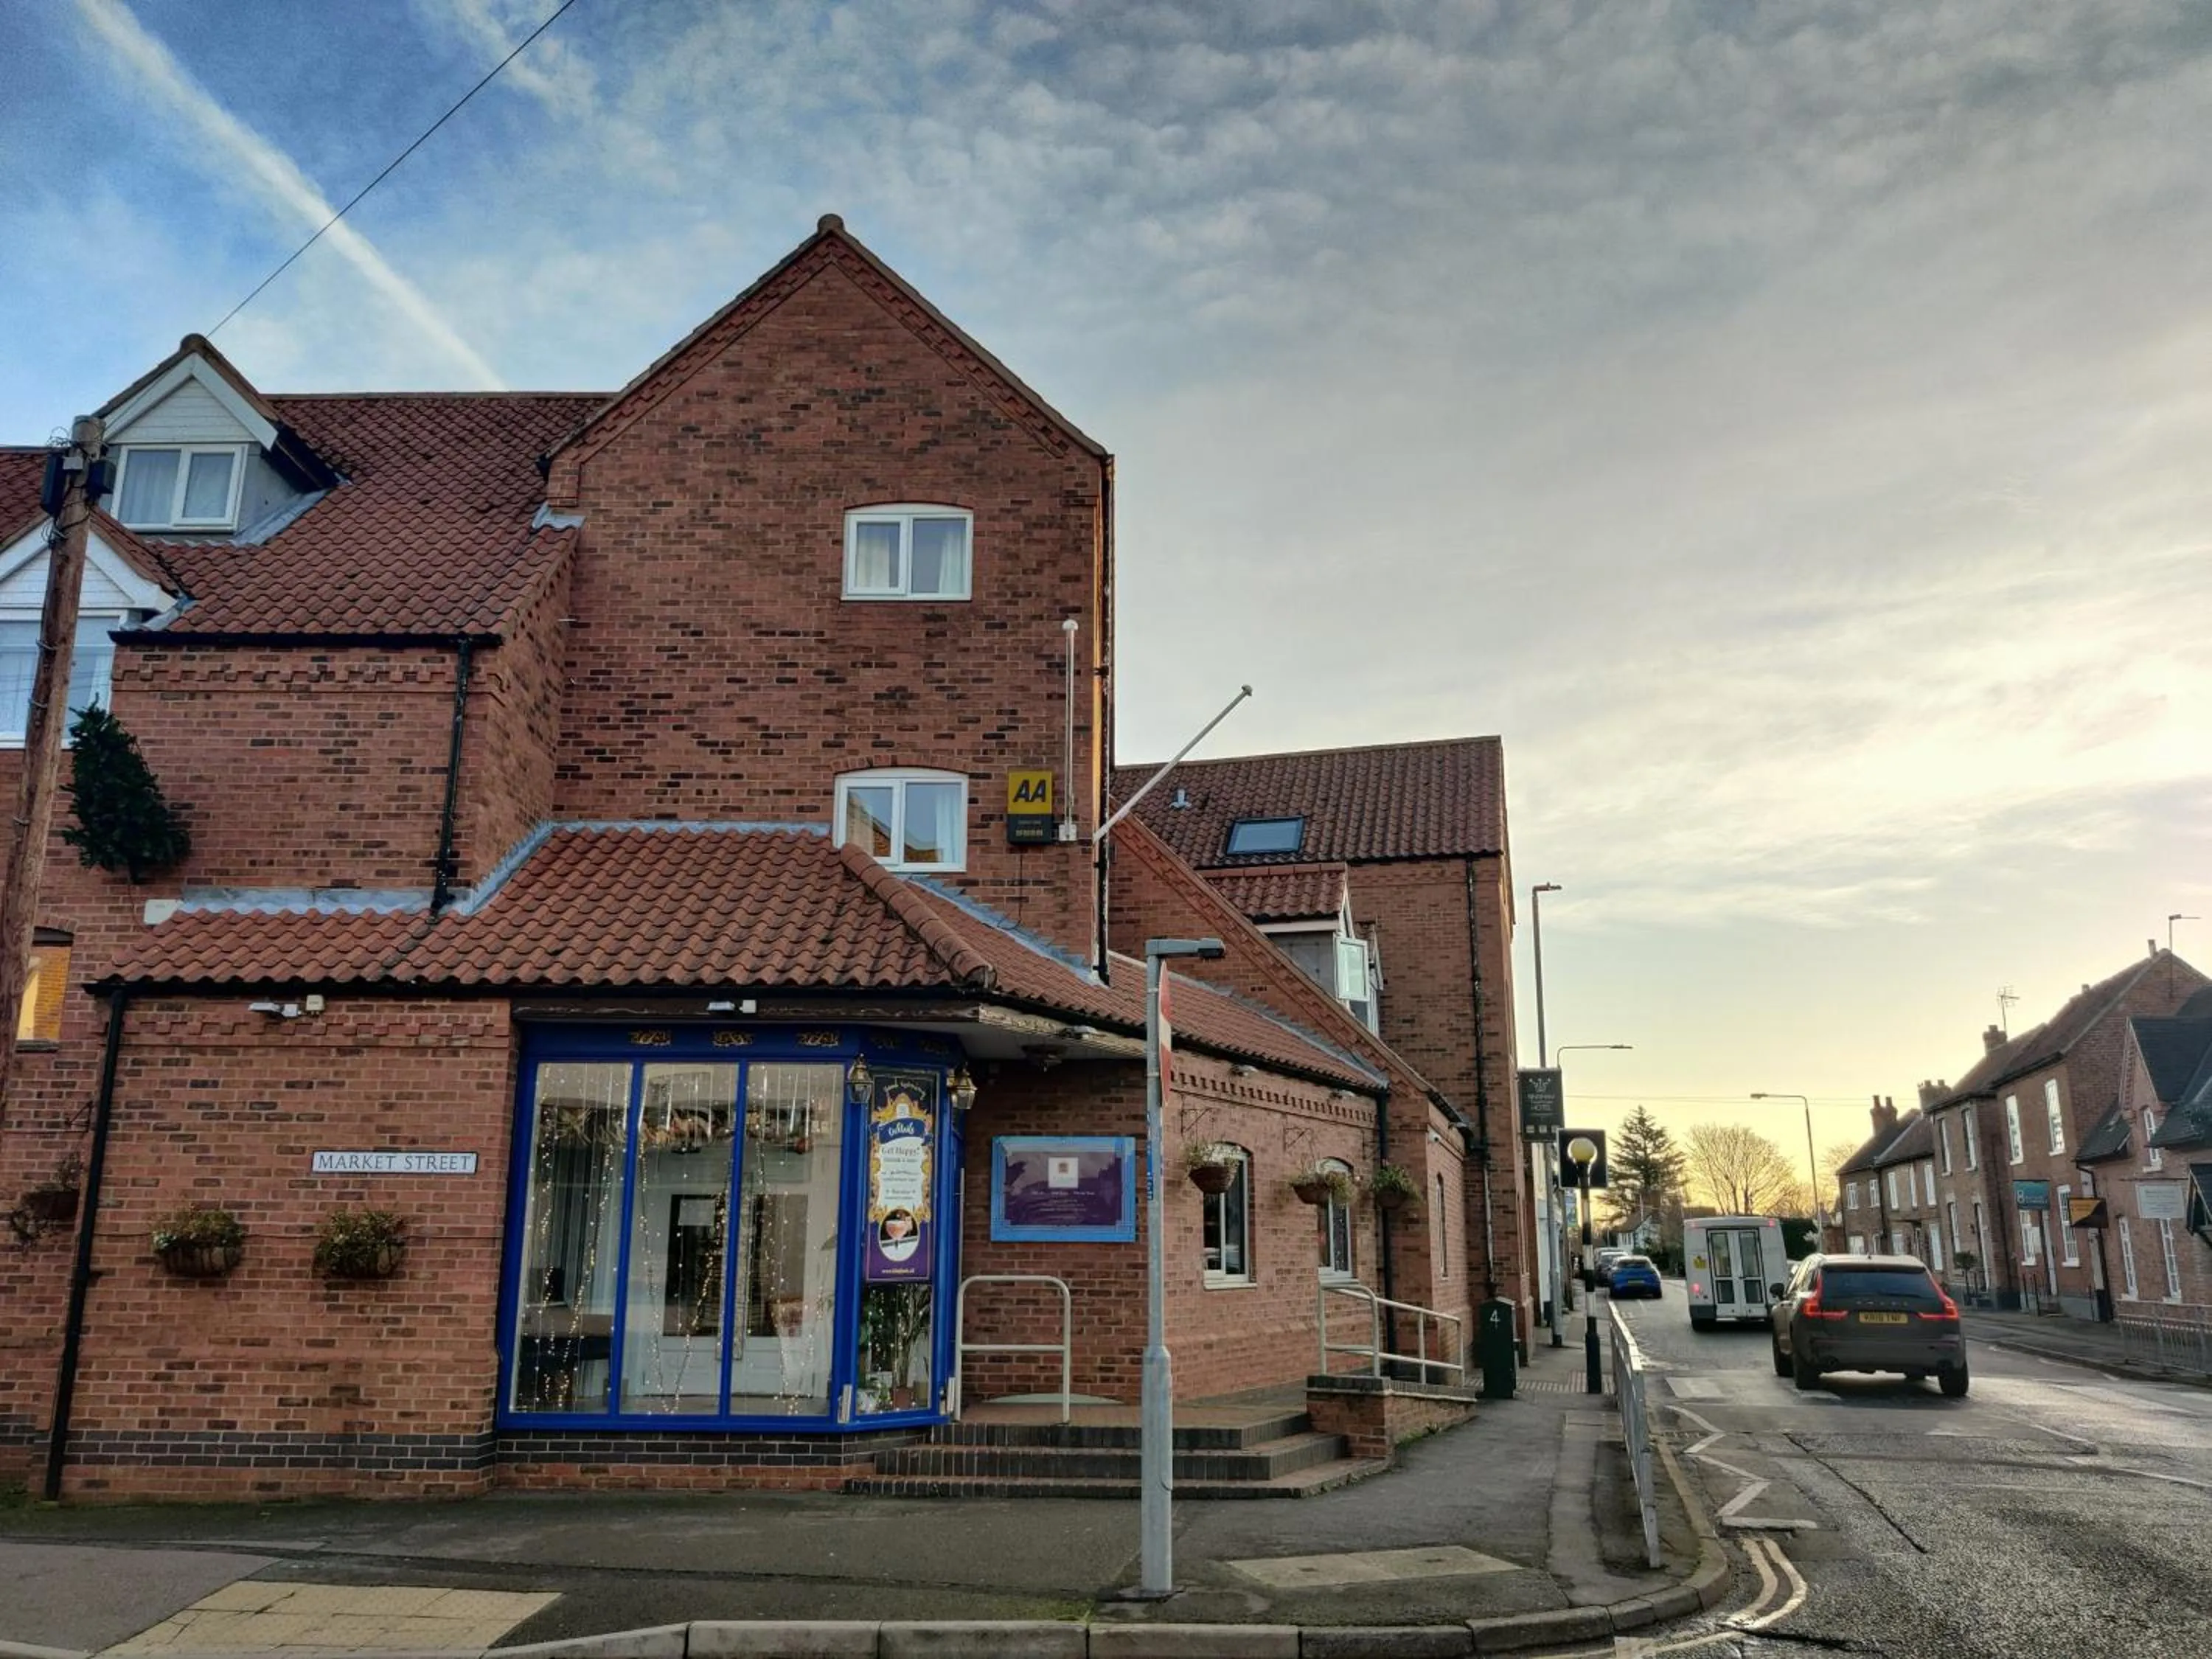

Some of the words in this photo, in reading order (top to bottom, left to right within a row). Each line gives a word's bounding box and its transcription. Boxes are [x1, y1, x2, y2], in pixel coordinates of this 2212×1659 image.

[1013, 779, 1046, 802] AA
[318, 1155, 396, 1169] MARKET
[405, 1155, 471, 1169] STREET
[1489, 1309, 1500, 1328] 4
